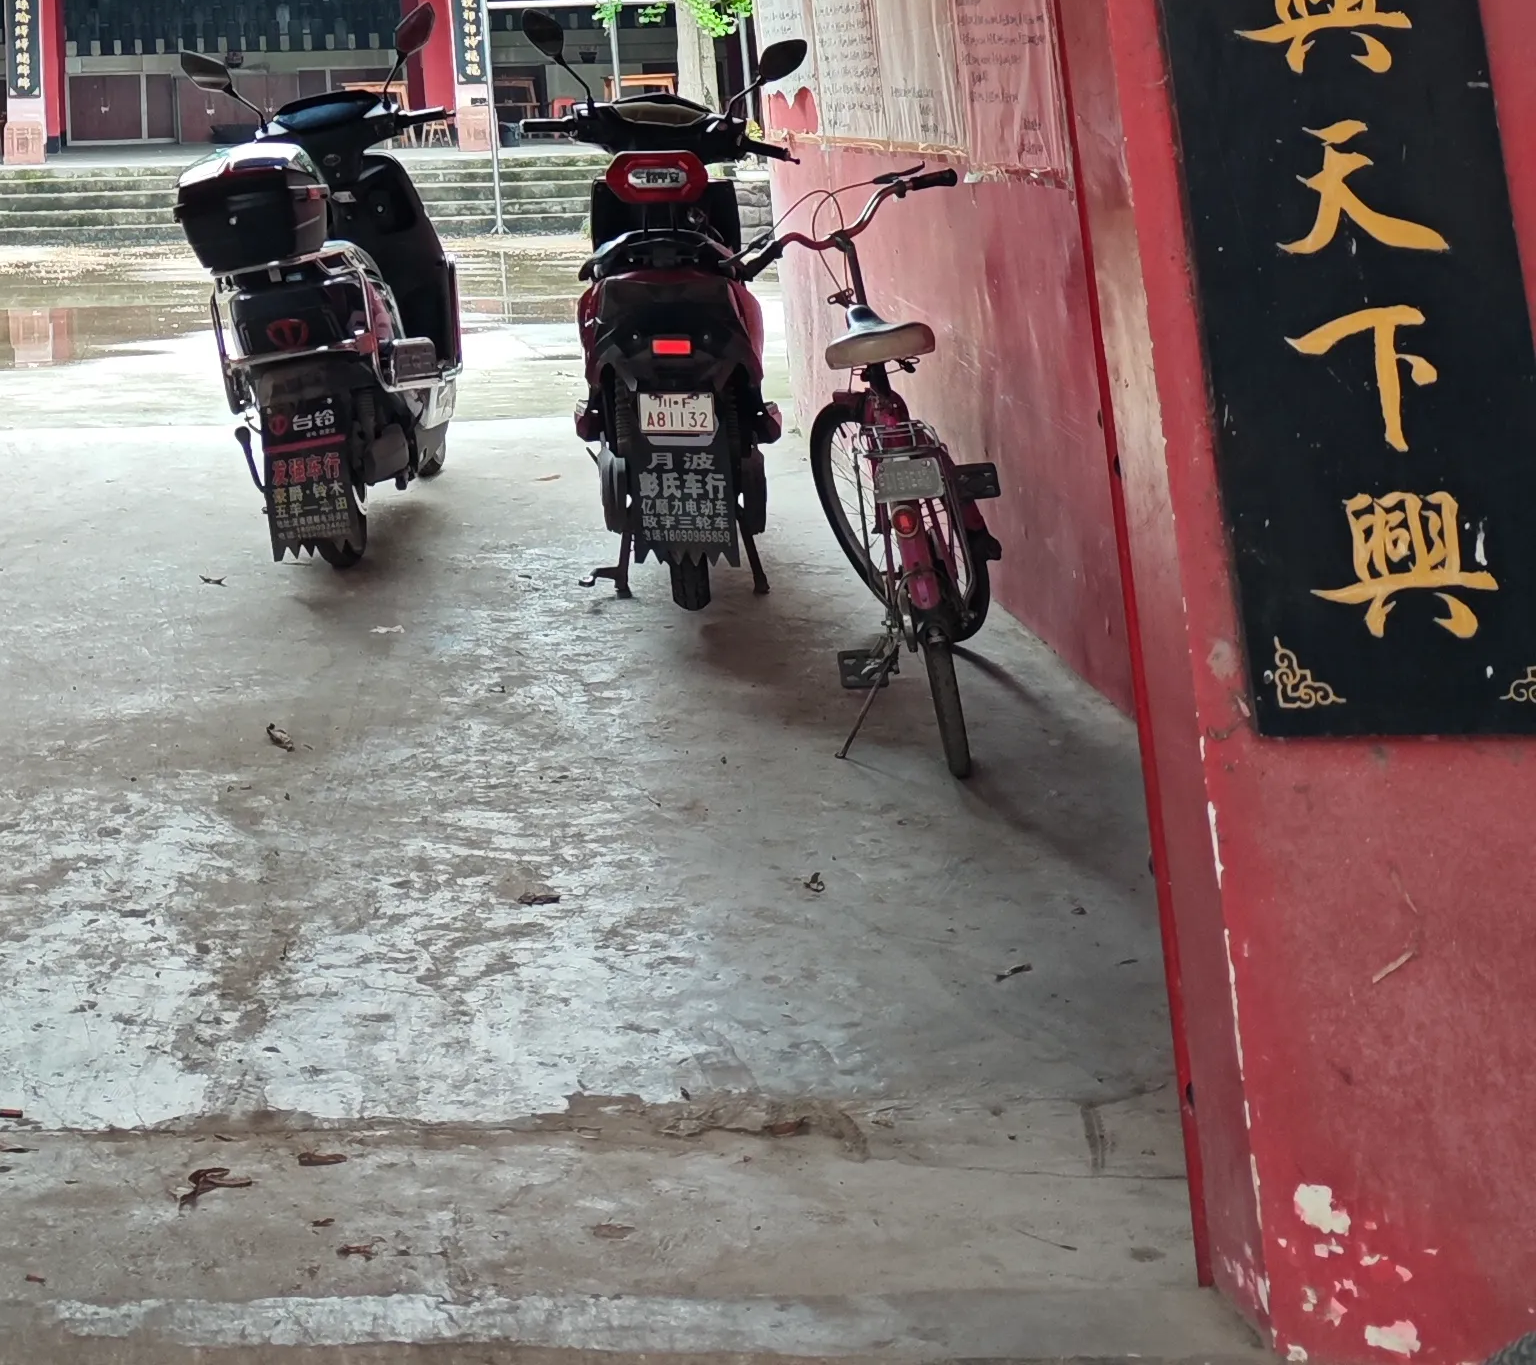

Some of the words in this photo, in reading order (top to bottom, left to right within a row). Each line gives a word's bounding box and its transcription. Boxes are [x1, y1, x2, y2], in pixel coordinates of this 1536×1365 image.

[292, 409, 335, 431] 台铃
[647, 411, 708, 428] A81132
[647, 452, 715, 469] 月波
[639, 472, 726, 499] 彭氏车行
[641, 499, 728, 516] 亿顺力电动车
